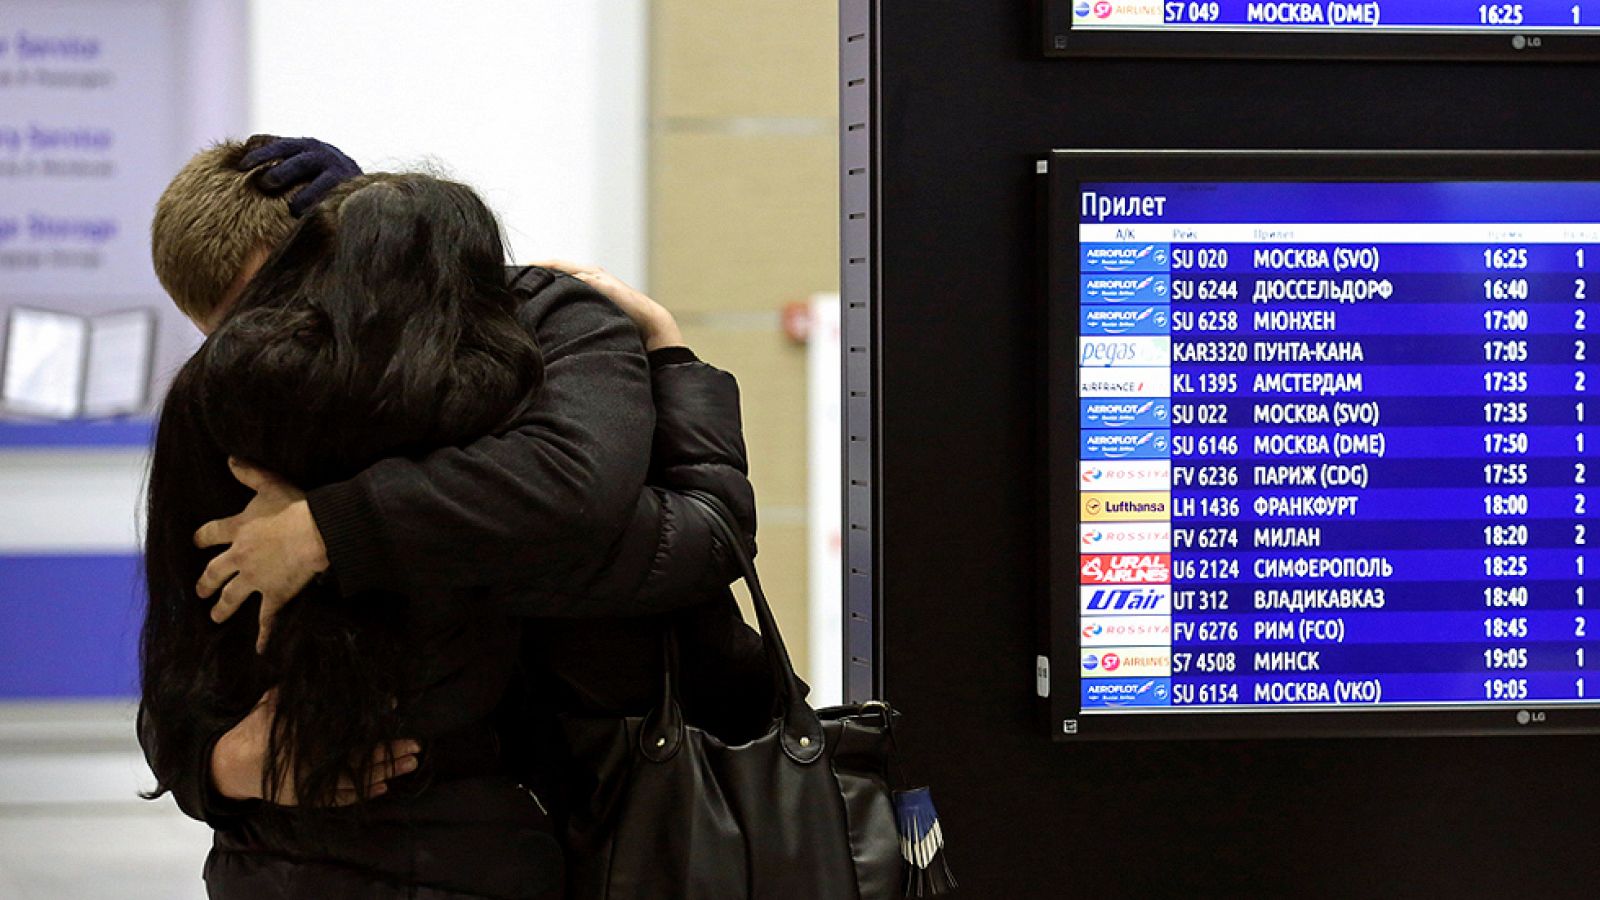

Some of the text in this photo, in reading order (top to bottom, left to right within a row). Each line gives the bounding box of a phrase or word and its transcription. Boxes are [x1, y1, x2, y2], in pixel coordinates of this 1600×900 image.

[1165, 1, 1580, 26] S7 049 МОСКВА (DME) 16:25 1
[1081, 191, 1167, 222] Прилет
[1087, 249, 1137, 257] AEROFLOT
[1172, 246, 1585, 272] SU 020 МОСКВА (SVO) 16:25 1
[1087, 280, 1137, 289] AEROFLOT
[1172, 279, 1586, 304] SU 6244 ДЮССЕЛЬДОРФ 16:40 2
[1087, 311, 1137, 320] AEROFLOT
[1172, 309, 1586, 331] SU 6258 МЮНХЕН 17:00 2
[1082, 342, 1136, 368] pegas
[1173, 340, 1586, 362] KAR3320 ПУНТА-КАНА 17:05 2
[1173, 371, 1586, 396] KL 1395 АМСТЕРДАМ 17:35 2
[1087, 404, 1137, 413] AEROFLOT
[1172, 402, 1584, 427] SU 022 МОСКВА (SVO) 17:35 1
[1087, 435, 1137, 444] AEROFLOT
[1172, 432, 1584, 458] SU 6146 МОСКВА (DME) 17:50 1
[1106, 470, 1168, 479] ROSSIYA
[1173, 463, 1585, 489] FV 6236 ПАРИЖ (CDG) 17:55 2
[1105, 501, 1165, 512] Lufthansa
[1173, 494, 1585, 517] LH 1436 ФРАНКФУРТ 18:00 2
[1106, 532, 1168, 541] ROSSIYA
[1173, 525, 1586, 548] FV 6274 МИЛАН 18:20 2
[1110, 555, 1165, 569] URAL
[1173, 556, 1584, 579] U6 2124 СИМФЕРОПОЛЬ 18:25 1
[1086, 588, 1165, 610] UTair
[1173, 586, 1584, 613] UT 312 ВЛАДИКАВКАЗ 18:40 1
[1106, 625, 1169, 634] ROSSIYA
[1173, 617, 1586, 643] FV 6276 РИМ (FCO) 18:45 2
[1173, 647, 1584, 673] S7 4508 МИНСК 19:05 1
[1087, 685, 1138, 694] AEROFLOT
[1173, 678, 1584, 704] SU 6154 МОСКВА (VKO) 19:05 1
[1532, 712, 1546, 721] LG
